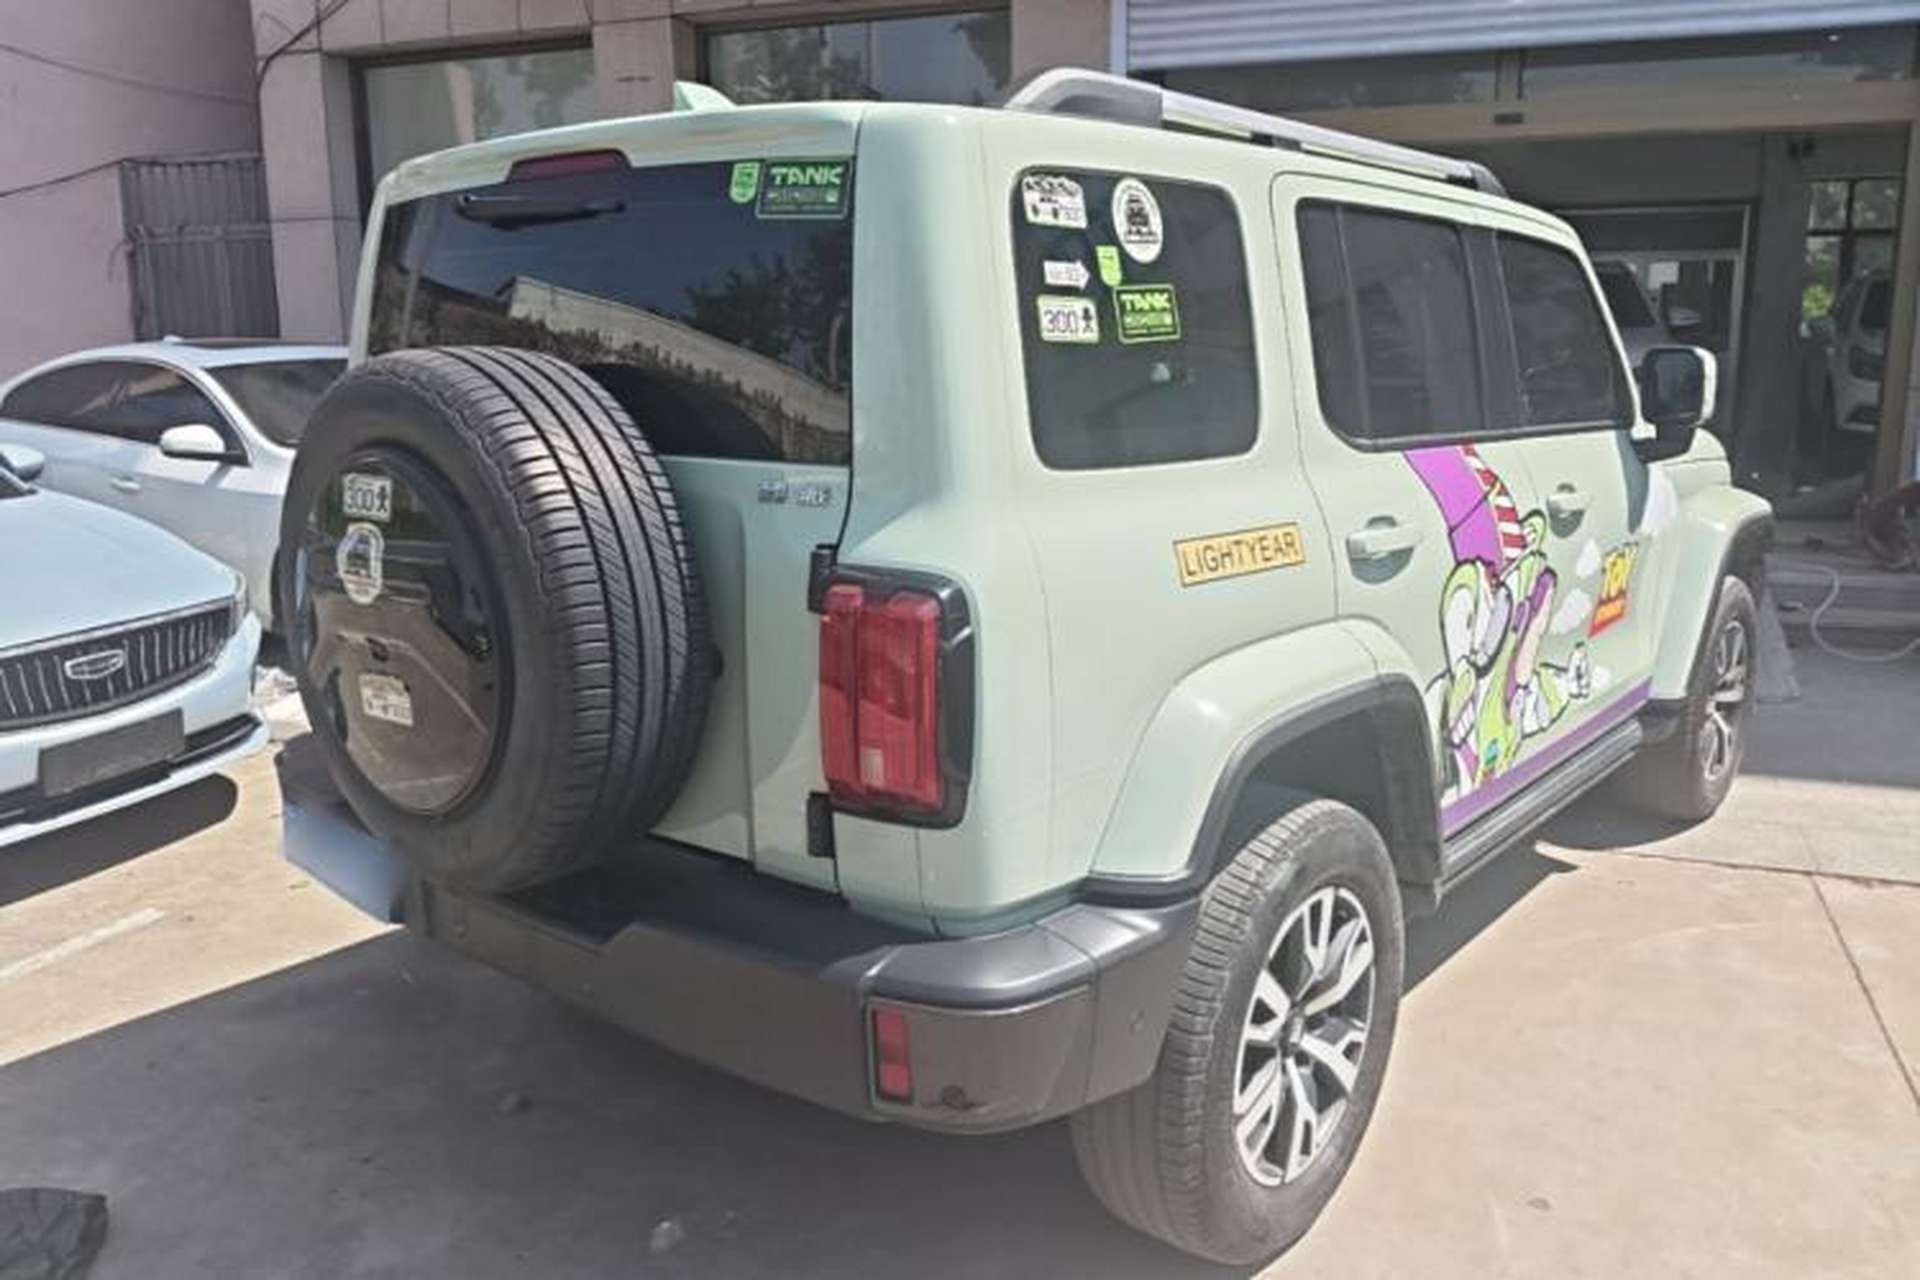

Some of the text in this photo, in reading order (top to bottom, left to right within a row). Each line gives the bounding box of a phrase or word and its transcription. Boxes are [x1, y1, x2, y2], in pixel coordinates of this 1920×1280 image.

[770, 166, 843, 185] TANK
[1119, 292, 1172, 311] TANK
[1044, 309, 1078, 333] 300
[1182, 531, 1299, 576] LIGHTYEAR
